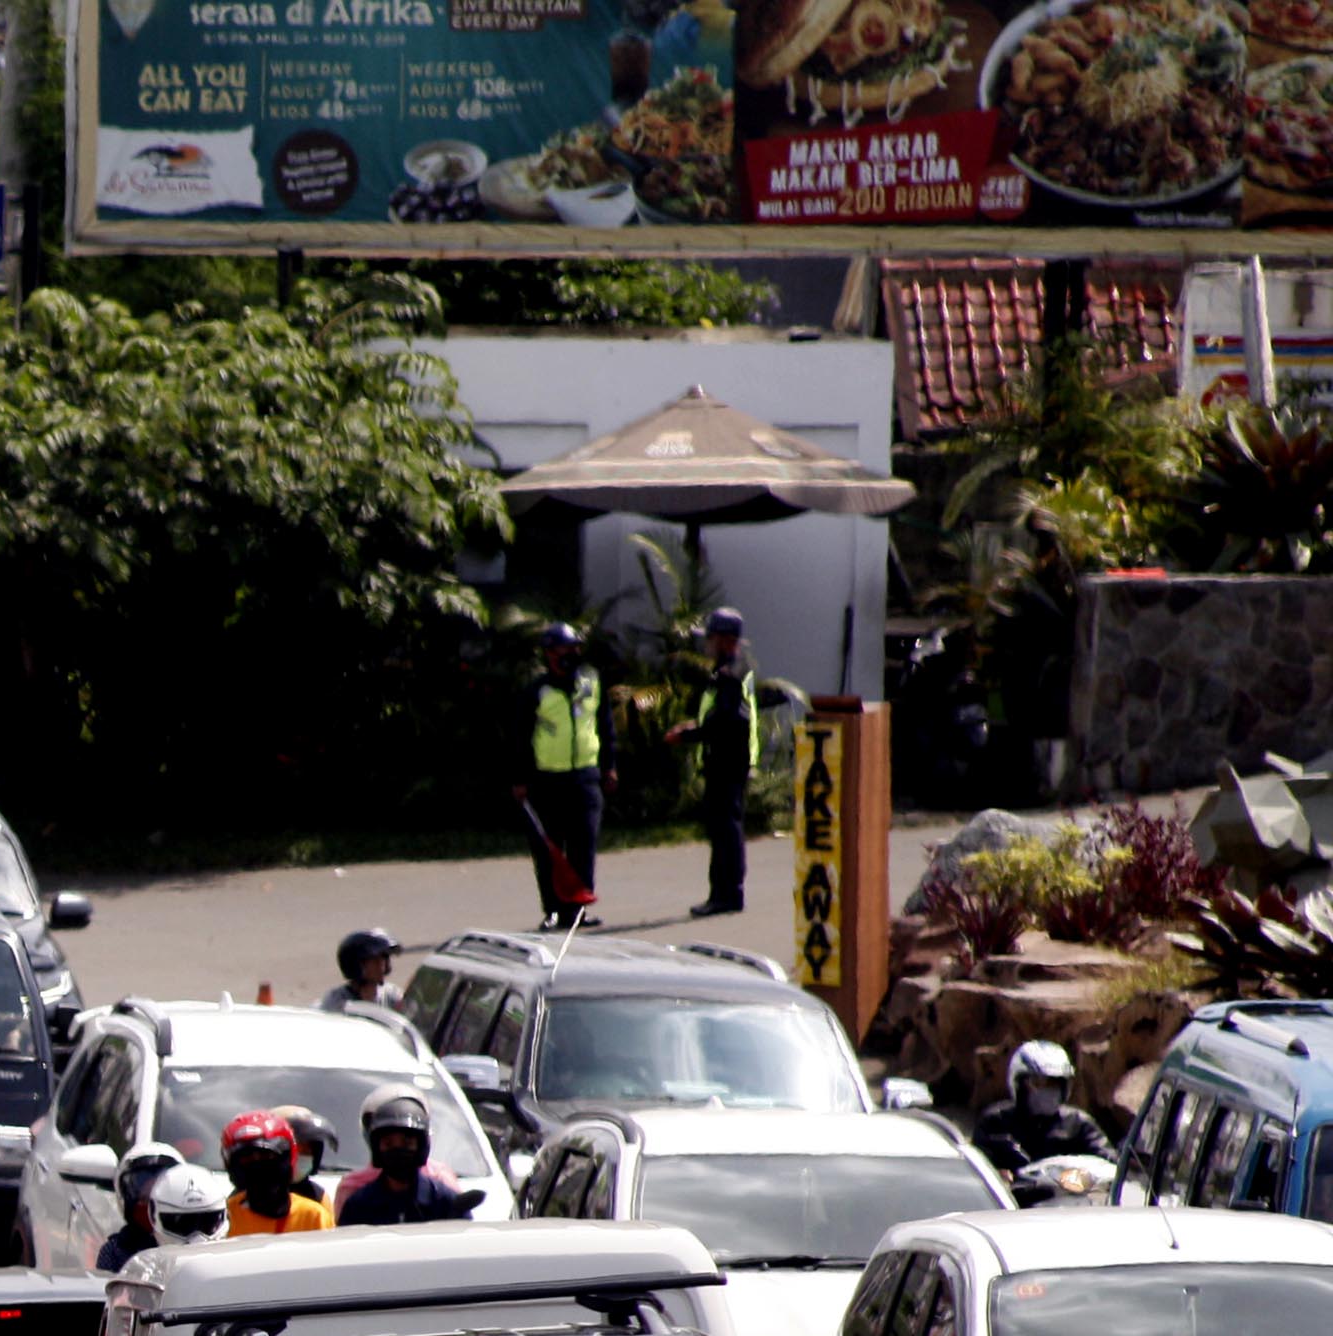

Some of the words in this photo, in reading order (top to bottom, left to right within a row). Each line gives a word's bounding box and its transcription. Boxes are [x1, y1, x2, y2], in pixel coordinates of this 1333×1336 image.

[505, 15, 537, 29] DAY
[137, 63, 184, 87] ALL
[192, 64, 247, 88] YOU
[137, 89, 190, 113] CAN
[199, 90, 248, 114] EAT
[788, 138, 860, 166] MAKIN
